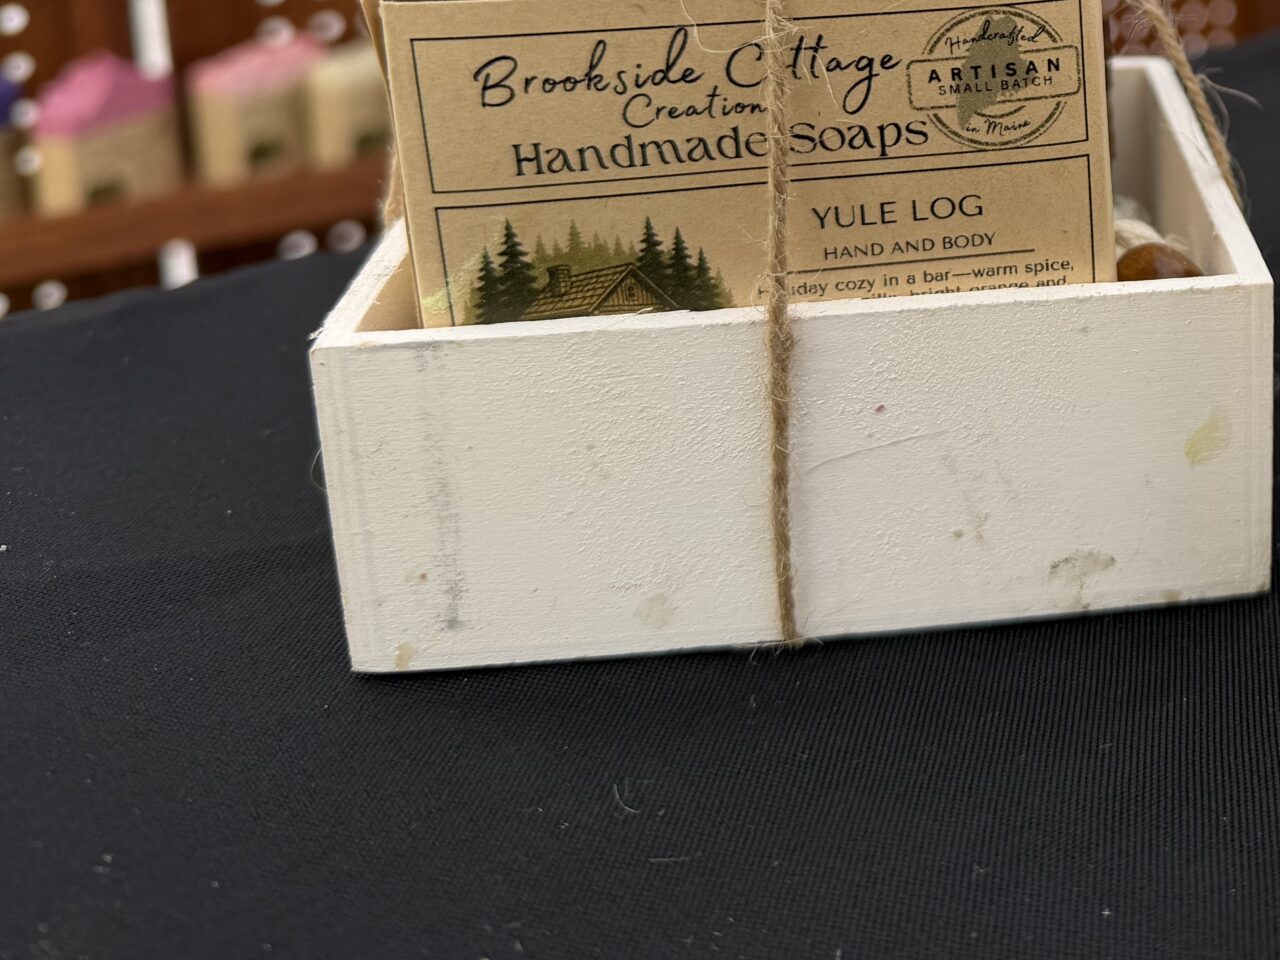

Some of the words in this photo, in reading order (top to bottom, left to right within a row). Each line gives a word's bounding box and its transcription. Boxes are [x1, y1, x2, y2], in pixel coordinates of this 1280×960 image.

[945, 20, 1047, 55] Handcrafted
[473, 26, 703, 109] Brookside
[726, 34, 902, 115] Cttage
[928, 57, 1061, 83] ARTISAN
[938, 81, 993, 96] SMALL
[1001, 76, 1053, 91] BATCH
[622, 85, 768, 128] Creation
[965, 123, 980, 134] in
[984, 118, 1030, 137] Maine
[511, 125, 768, 177] Handmade
[788, 120, 929, 157] Soaps
[812, 201, 898, 229] YULE
[912, 194, 985, 222] LOG
[824, 242, 884, 261] HAND
[891, 238, 936, 255] AND
[942, 231, 996, 250] BODY
[835, 278, 876, 293] cozy
[883, 273, 899, 287] in
[906, 273, 916, 285] a
[1024, 258, 1074, 276] spice,
